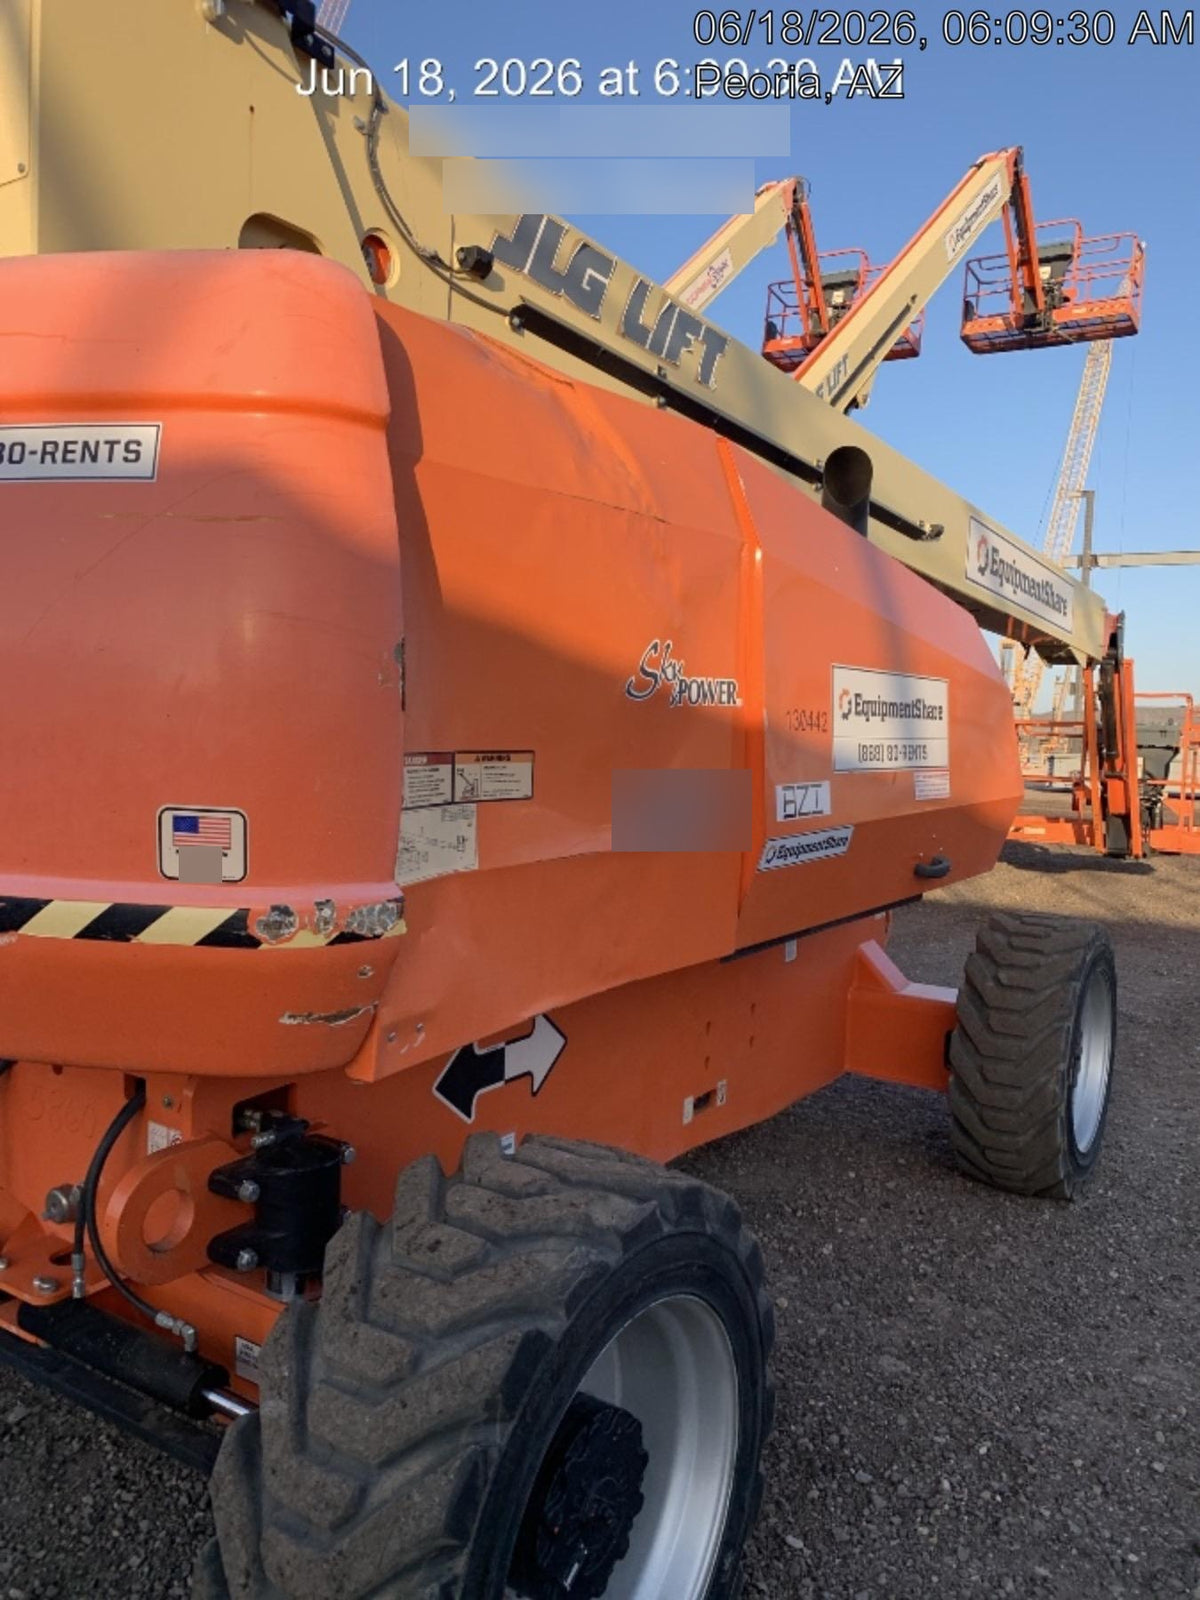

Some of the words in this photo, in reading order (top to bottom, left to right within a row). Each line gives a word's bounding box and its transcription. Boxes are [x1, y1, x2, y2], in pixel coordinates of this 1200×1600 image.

[488, 214, 618, 323] JLG
[618, 275, 732, 391] LIFT
[626, 639, 685, 708] Sky
[678, 677, 737, 706] POWER
[854, 692, 943, 722] EquipmentShare
